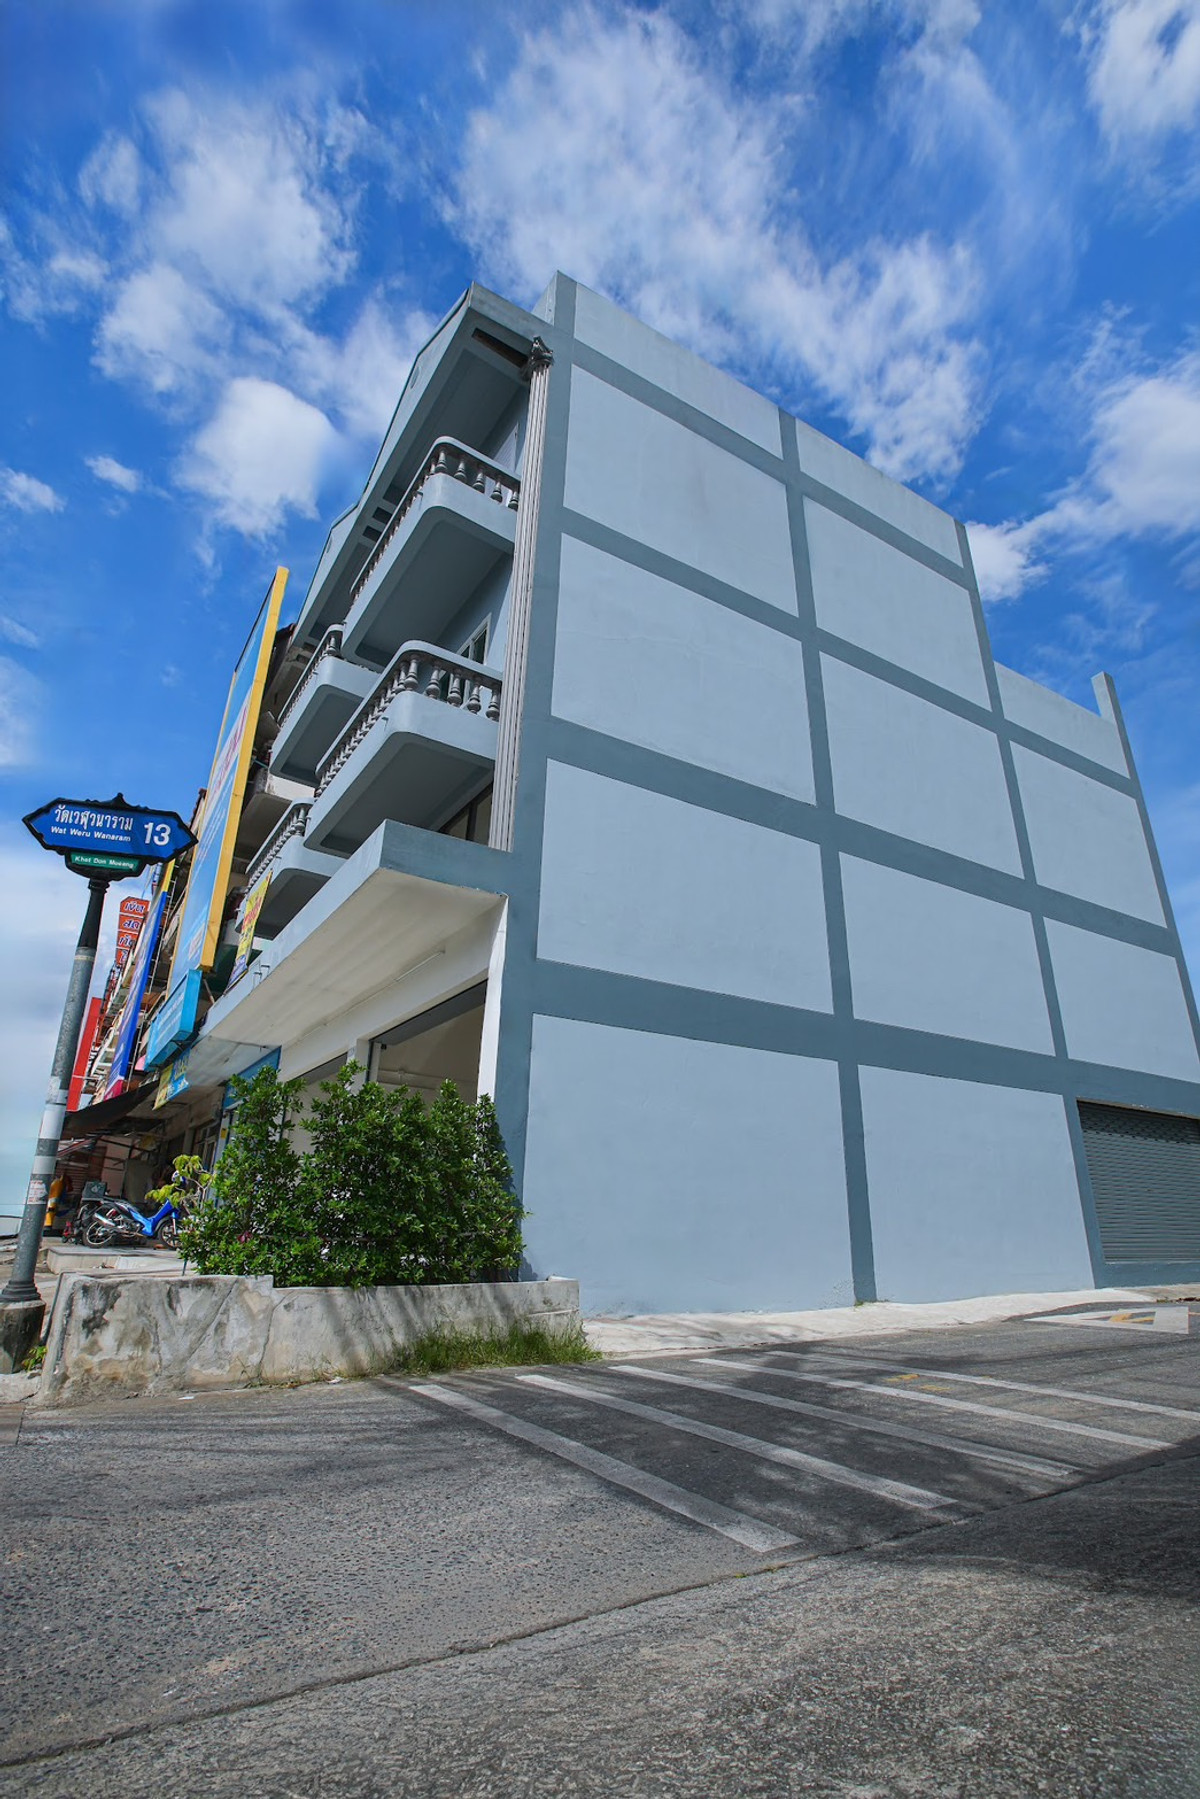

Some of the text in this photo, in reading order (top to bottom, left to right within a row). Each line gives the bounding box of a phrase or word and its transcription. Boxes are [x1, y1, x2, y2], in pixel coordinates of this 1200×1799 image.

[54, 805, 134, 831] วัดเวฬุวนาราม
[51, 826, 131, 842] Wat Weru Wanaram
[144, 823, 172, 846] 13
[74, 855, 135, 869] Khet Don Mueang
